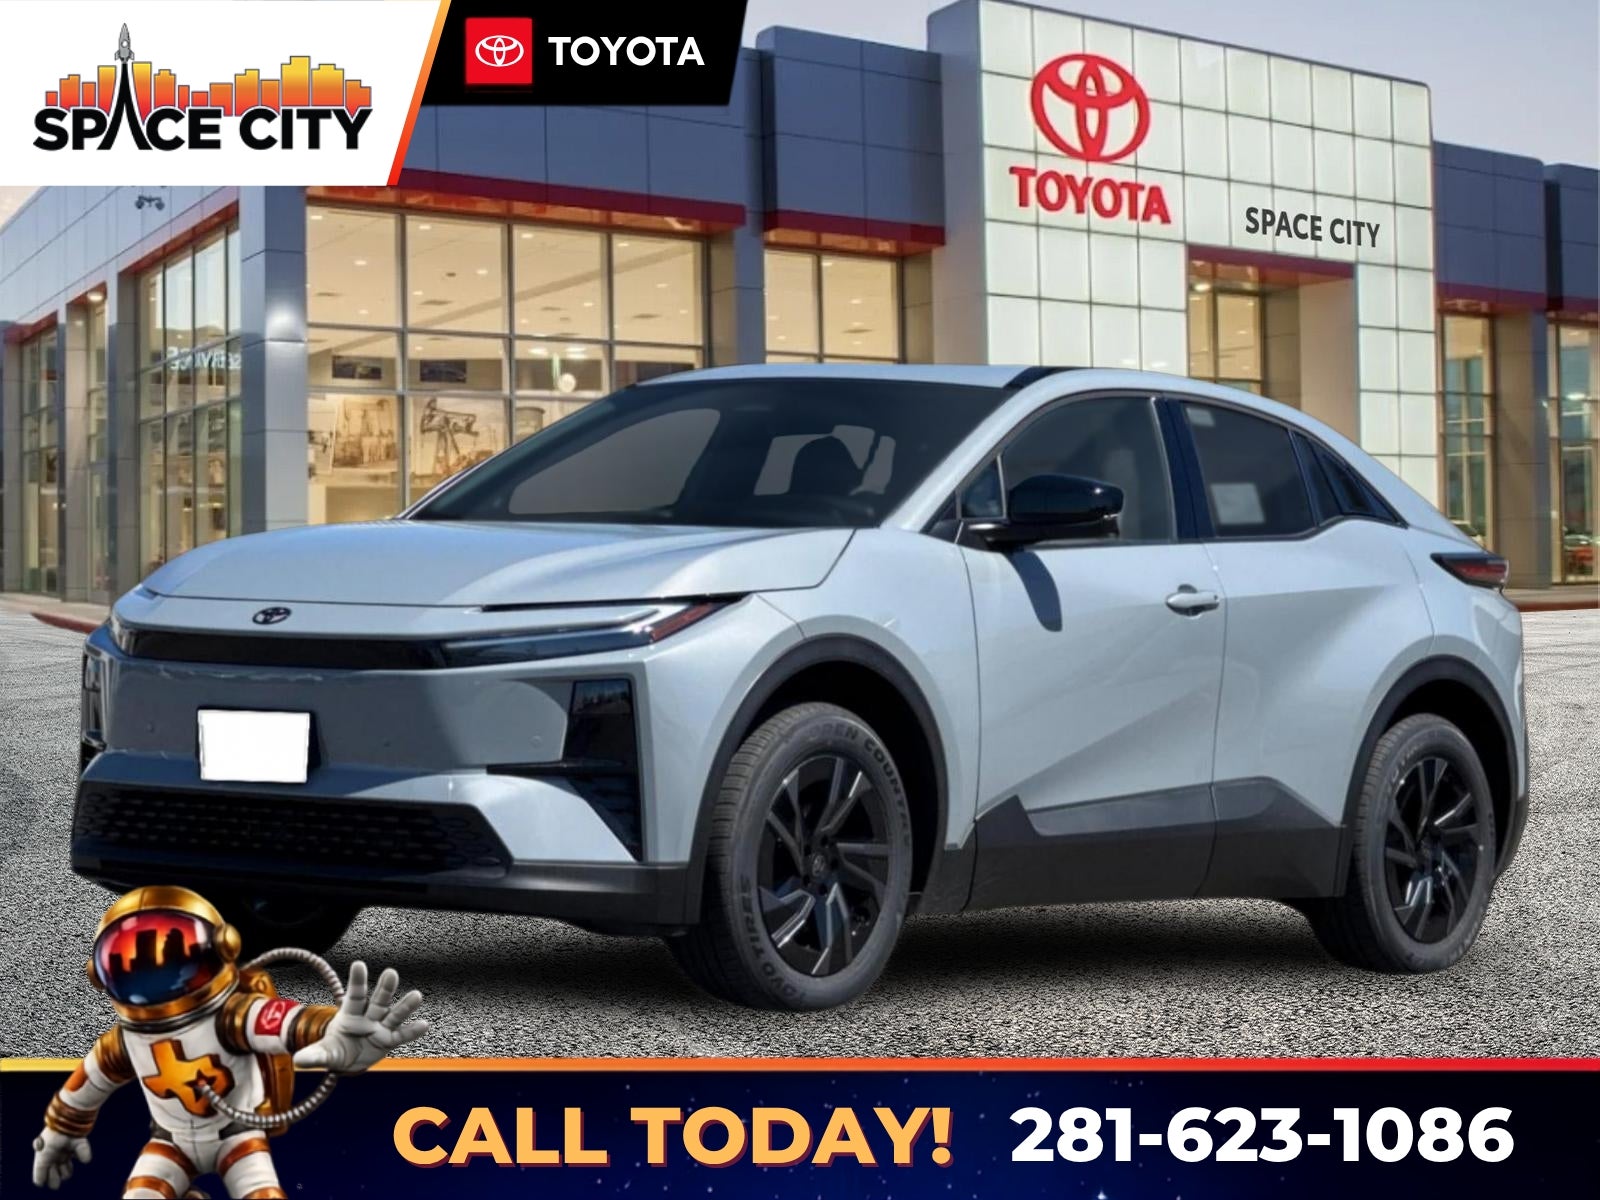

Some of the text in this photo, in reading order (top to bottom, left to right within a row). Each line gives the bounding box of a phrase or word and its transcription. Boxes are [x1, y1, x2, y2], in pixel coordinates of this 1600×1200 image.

[1009, 166, 1170, 224] TOYOTA
[1245, 206, 1381, 248] SPACE CITY
